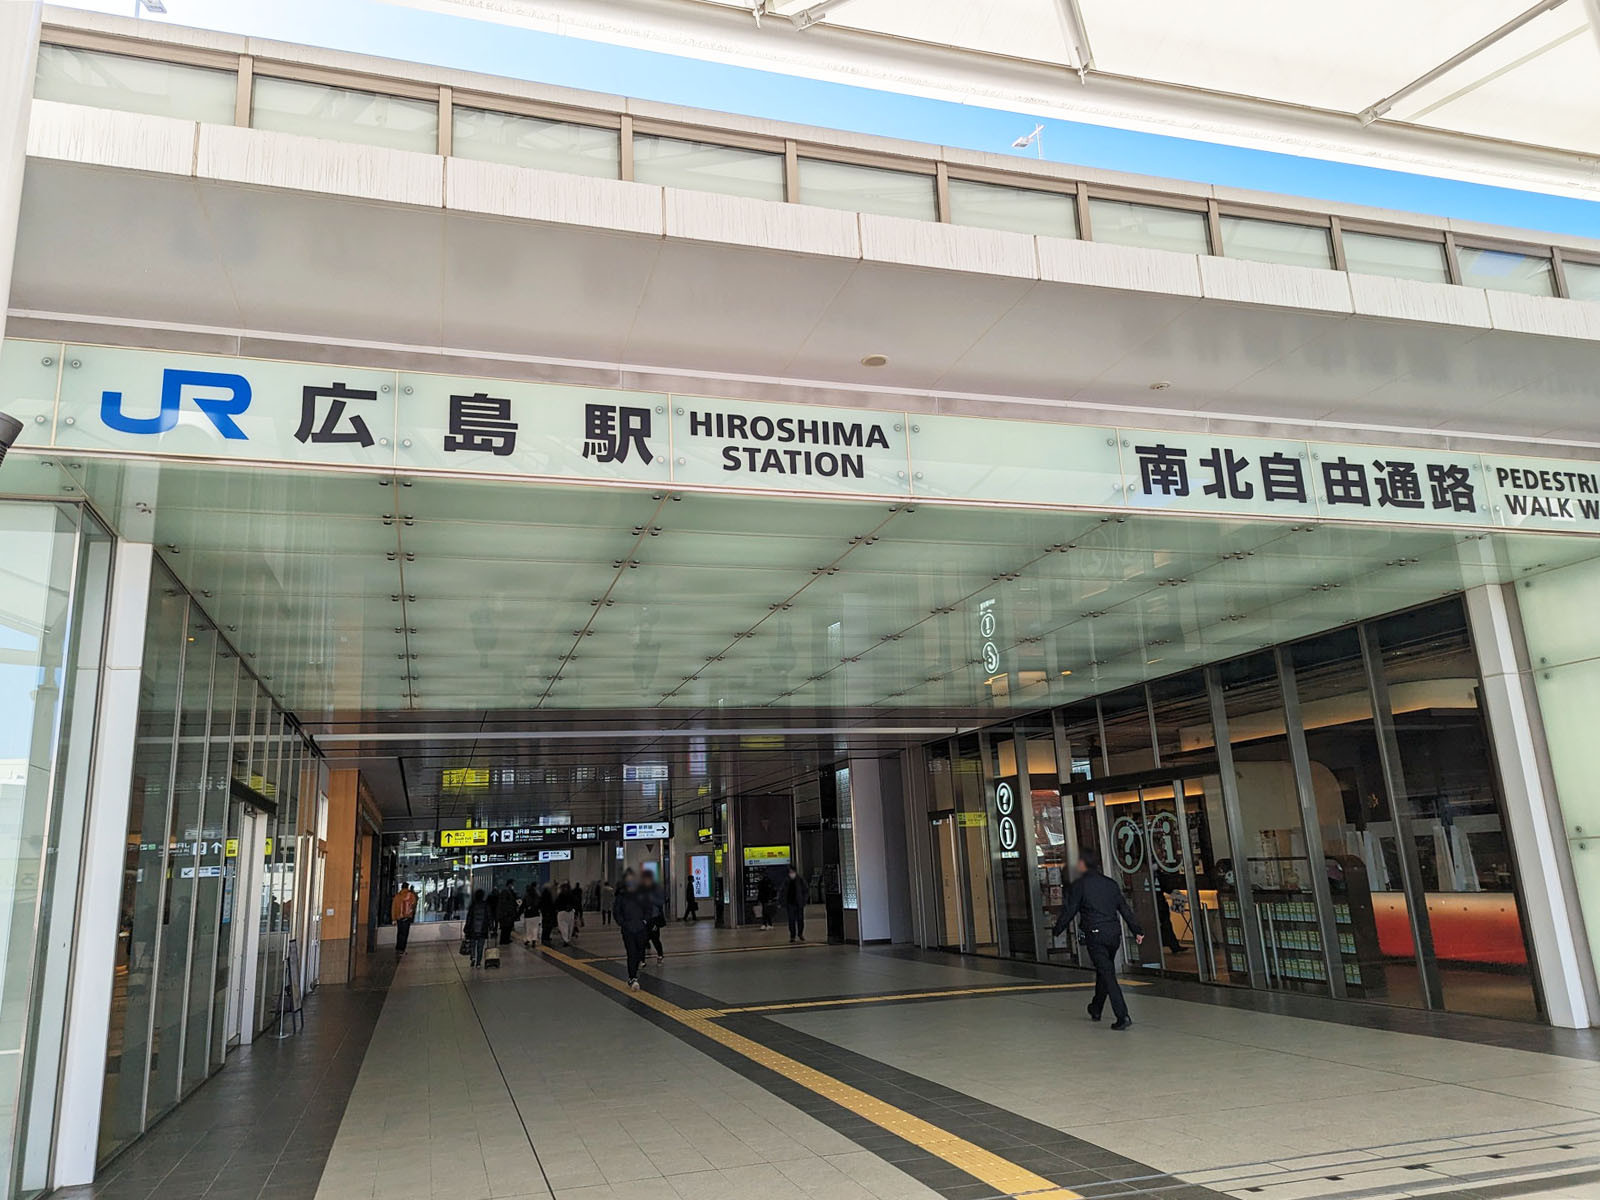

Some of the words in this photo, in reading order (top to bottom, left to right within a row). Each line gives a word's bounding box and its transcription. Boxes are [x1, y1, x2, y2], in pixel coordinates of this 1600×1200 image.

[100, 368, 252, 441] JR
[294, 381, 654, 466] 広島駅
[689, 410, 890, 449] HIROSHIMA
[722, 445, 864, 479] STATION
[1134, 443, 1477, 514] 南北自由通路
[1504, 494, 1574, 518] WALK
